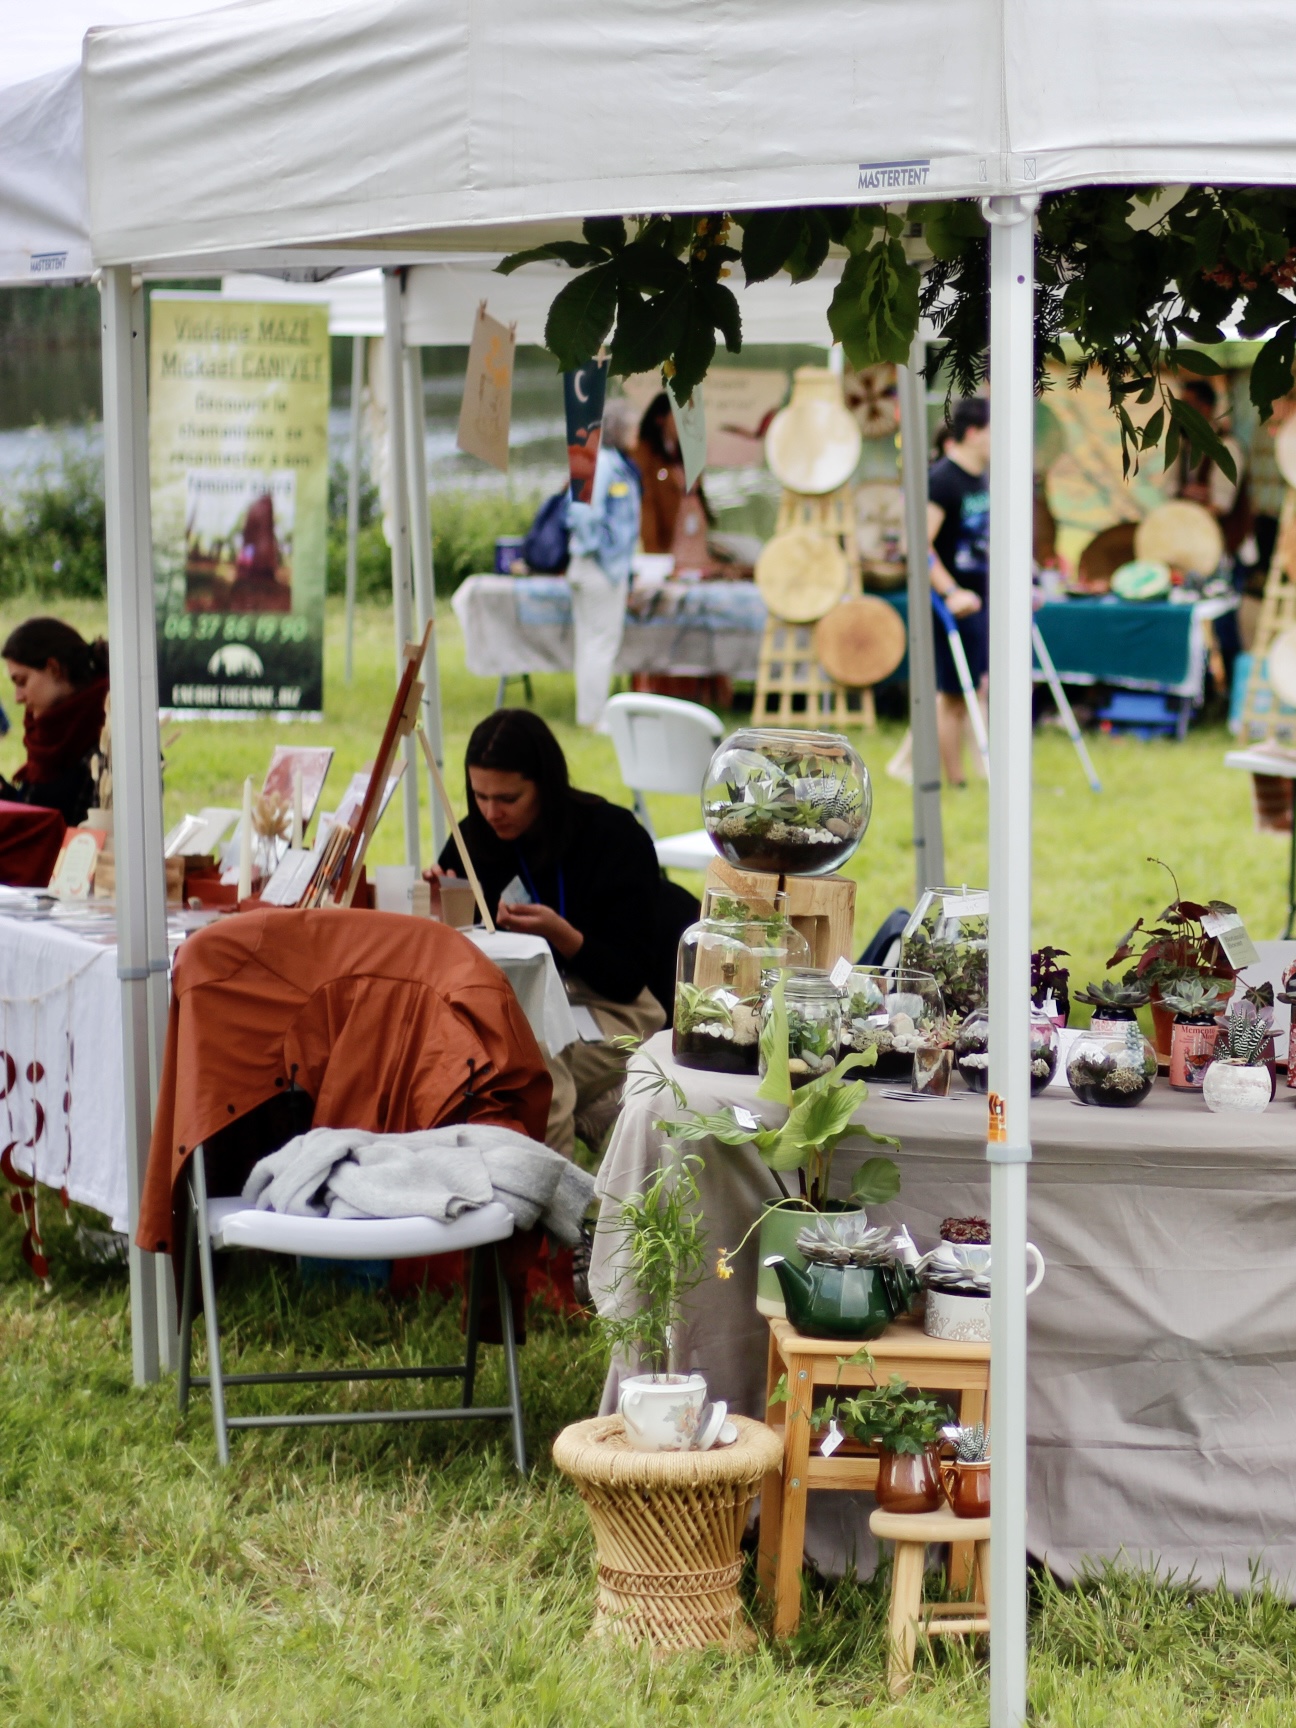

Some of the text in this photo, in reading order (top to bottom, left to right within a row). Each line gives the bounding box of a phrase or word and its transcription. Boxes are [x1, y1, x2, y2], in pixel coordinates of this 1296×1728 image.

[858, 167, 930, 189] MASTERTENT
[30, 257, 67, 273] MASTERTENT
[164, 613, 192, 641] 06
[195, 613, 222, 642] 37
[254, 614, 279, 644] 19
[279, 614, 308, 645] 90
